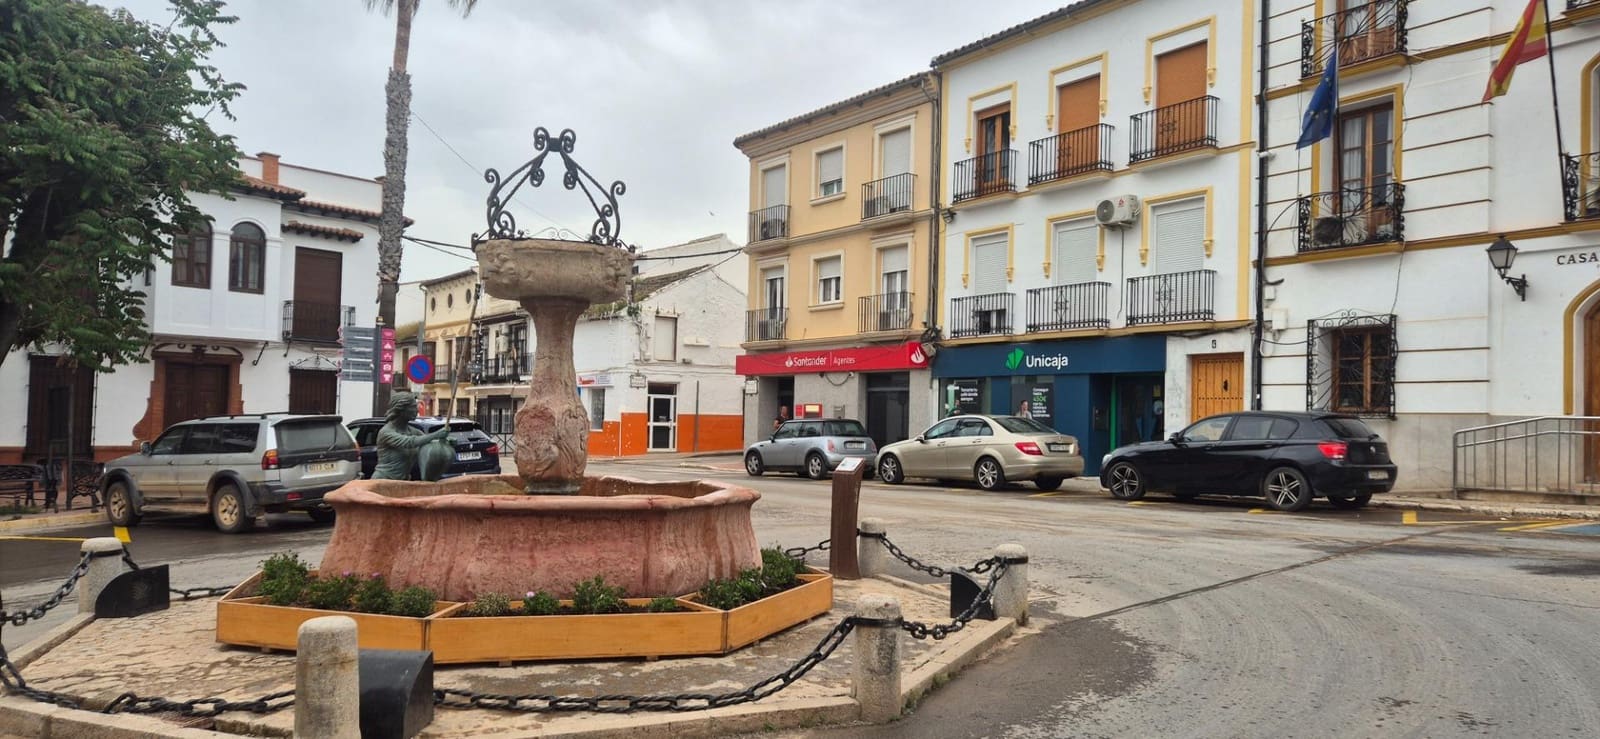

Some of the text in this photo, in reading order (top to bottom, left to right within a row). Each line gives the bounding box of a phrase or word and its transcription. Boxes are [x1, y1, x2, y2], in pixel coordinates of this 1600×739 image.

[1557, 252, 1599, 265] CASA
[793, 356, 856, 367] Santander Agentes
[1026, 354, 1068, 370] Unicaja
